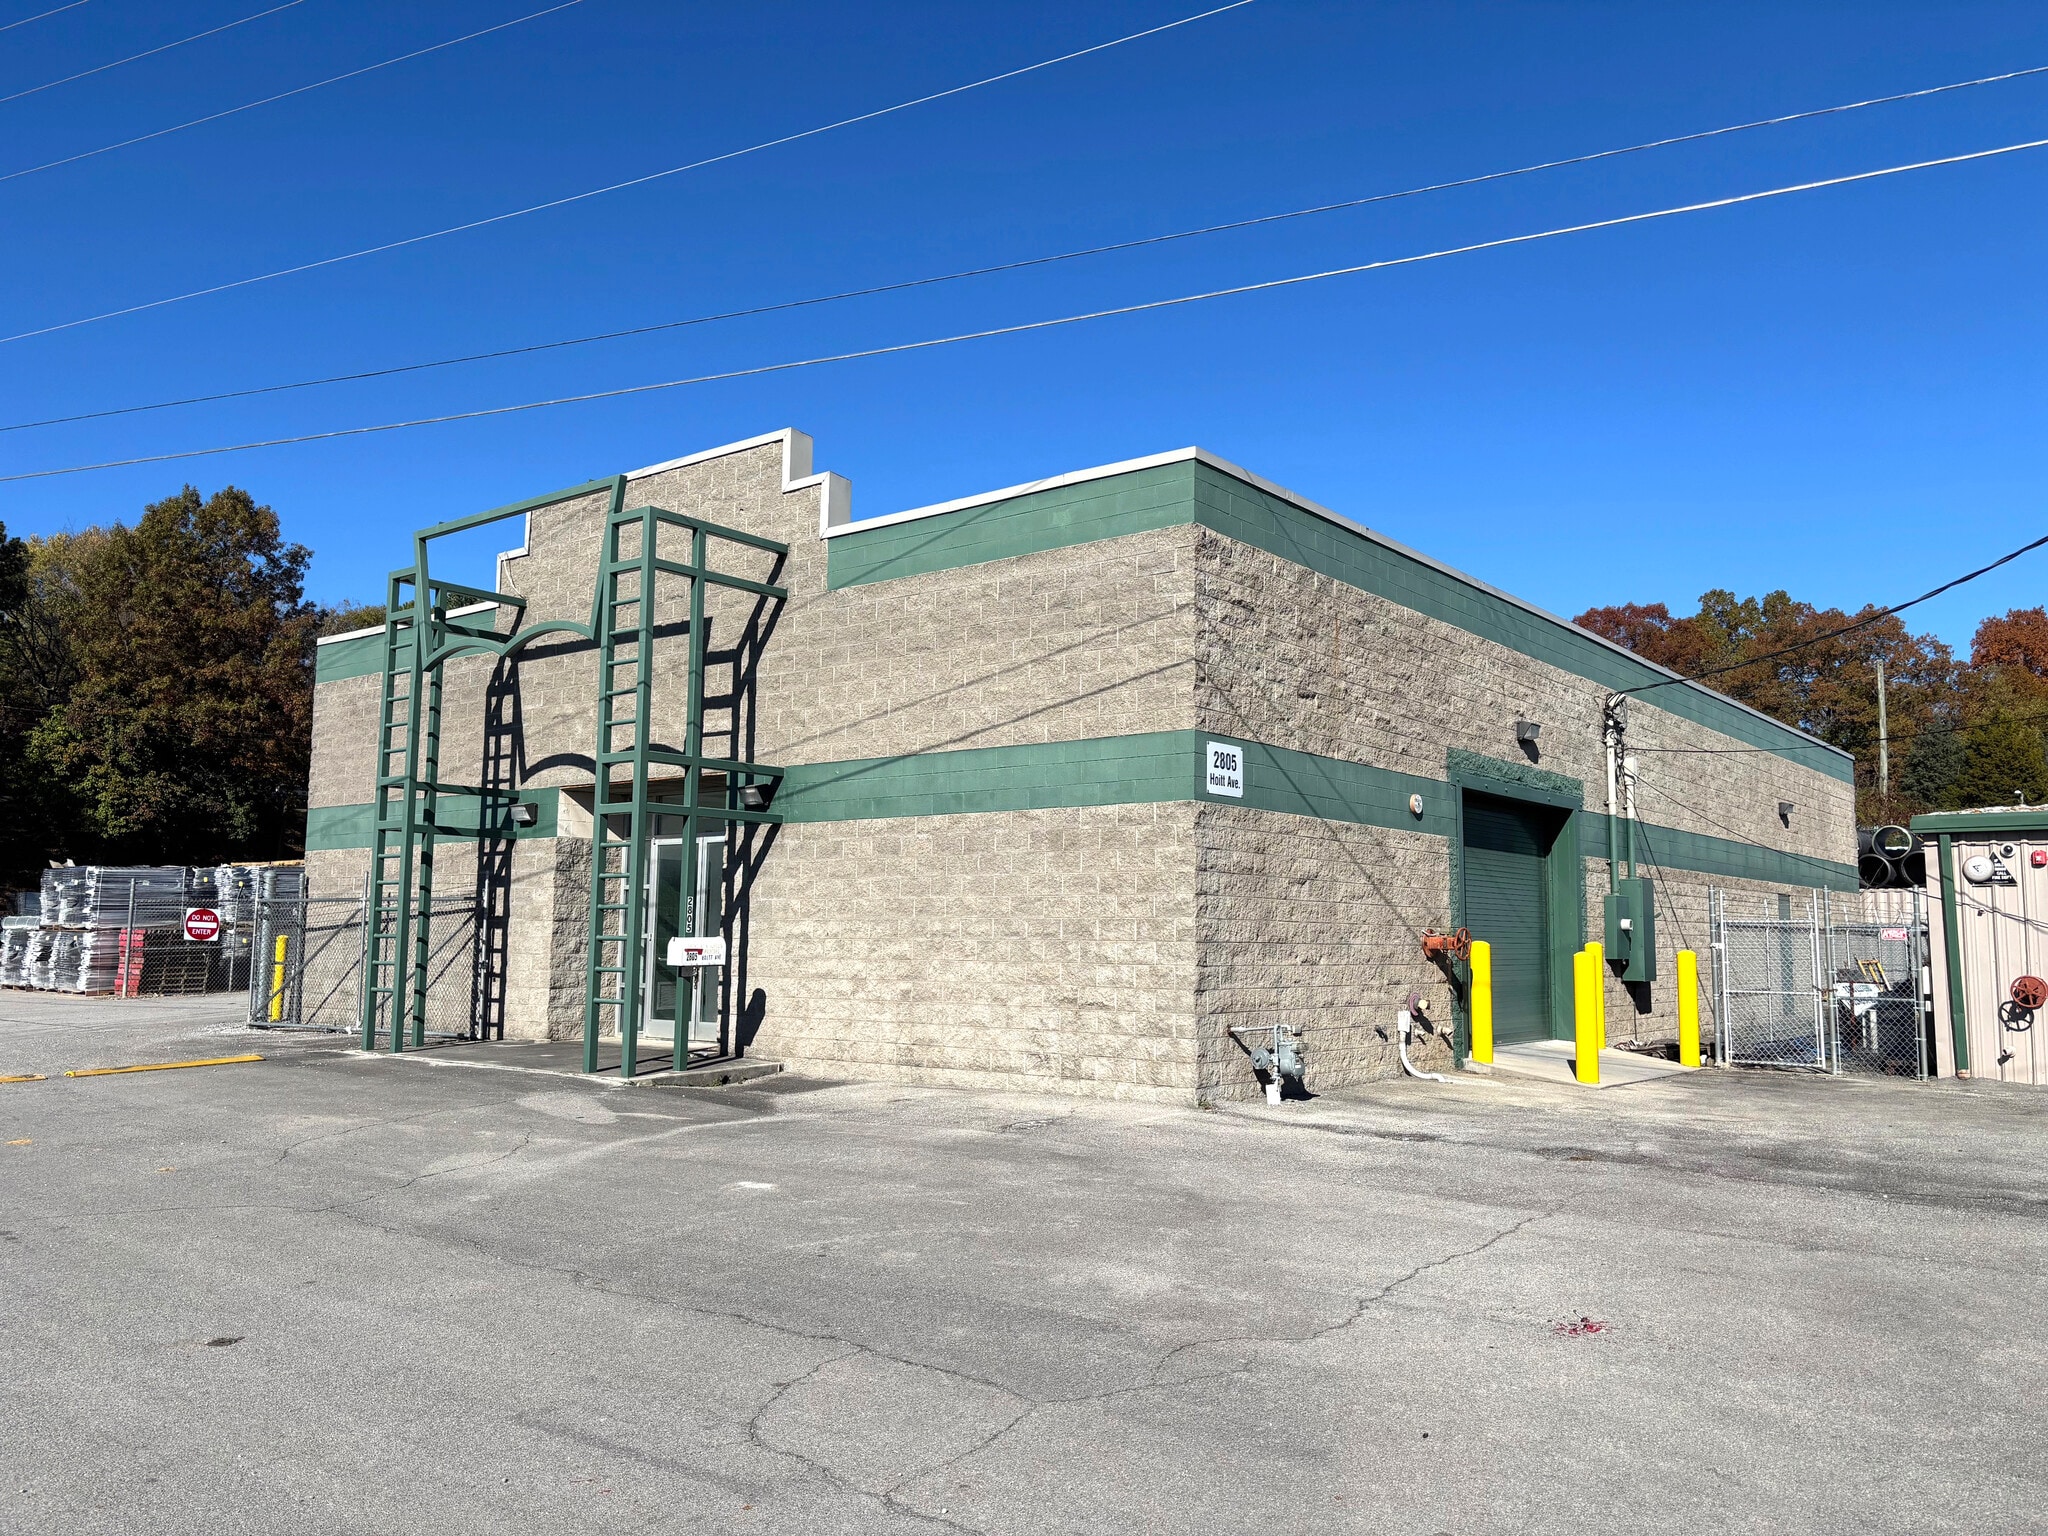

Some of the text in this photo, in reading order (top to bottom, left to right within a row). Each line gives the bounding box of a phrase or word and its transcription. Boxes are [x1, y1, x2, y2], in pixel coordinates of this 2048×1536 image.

[1213, 750, 1237, 771] 2805
[1210, 772, 1241, 789] Hoitt Ave.
